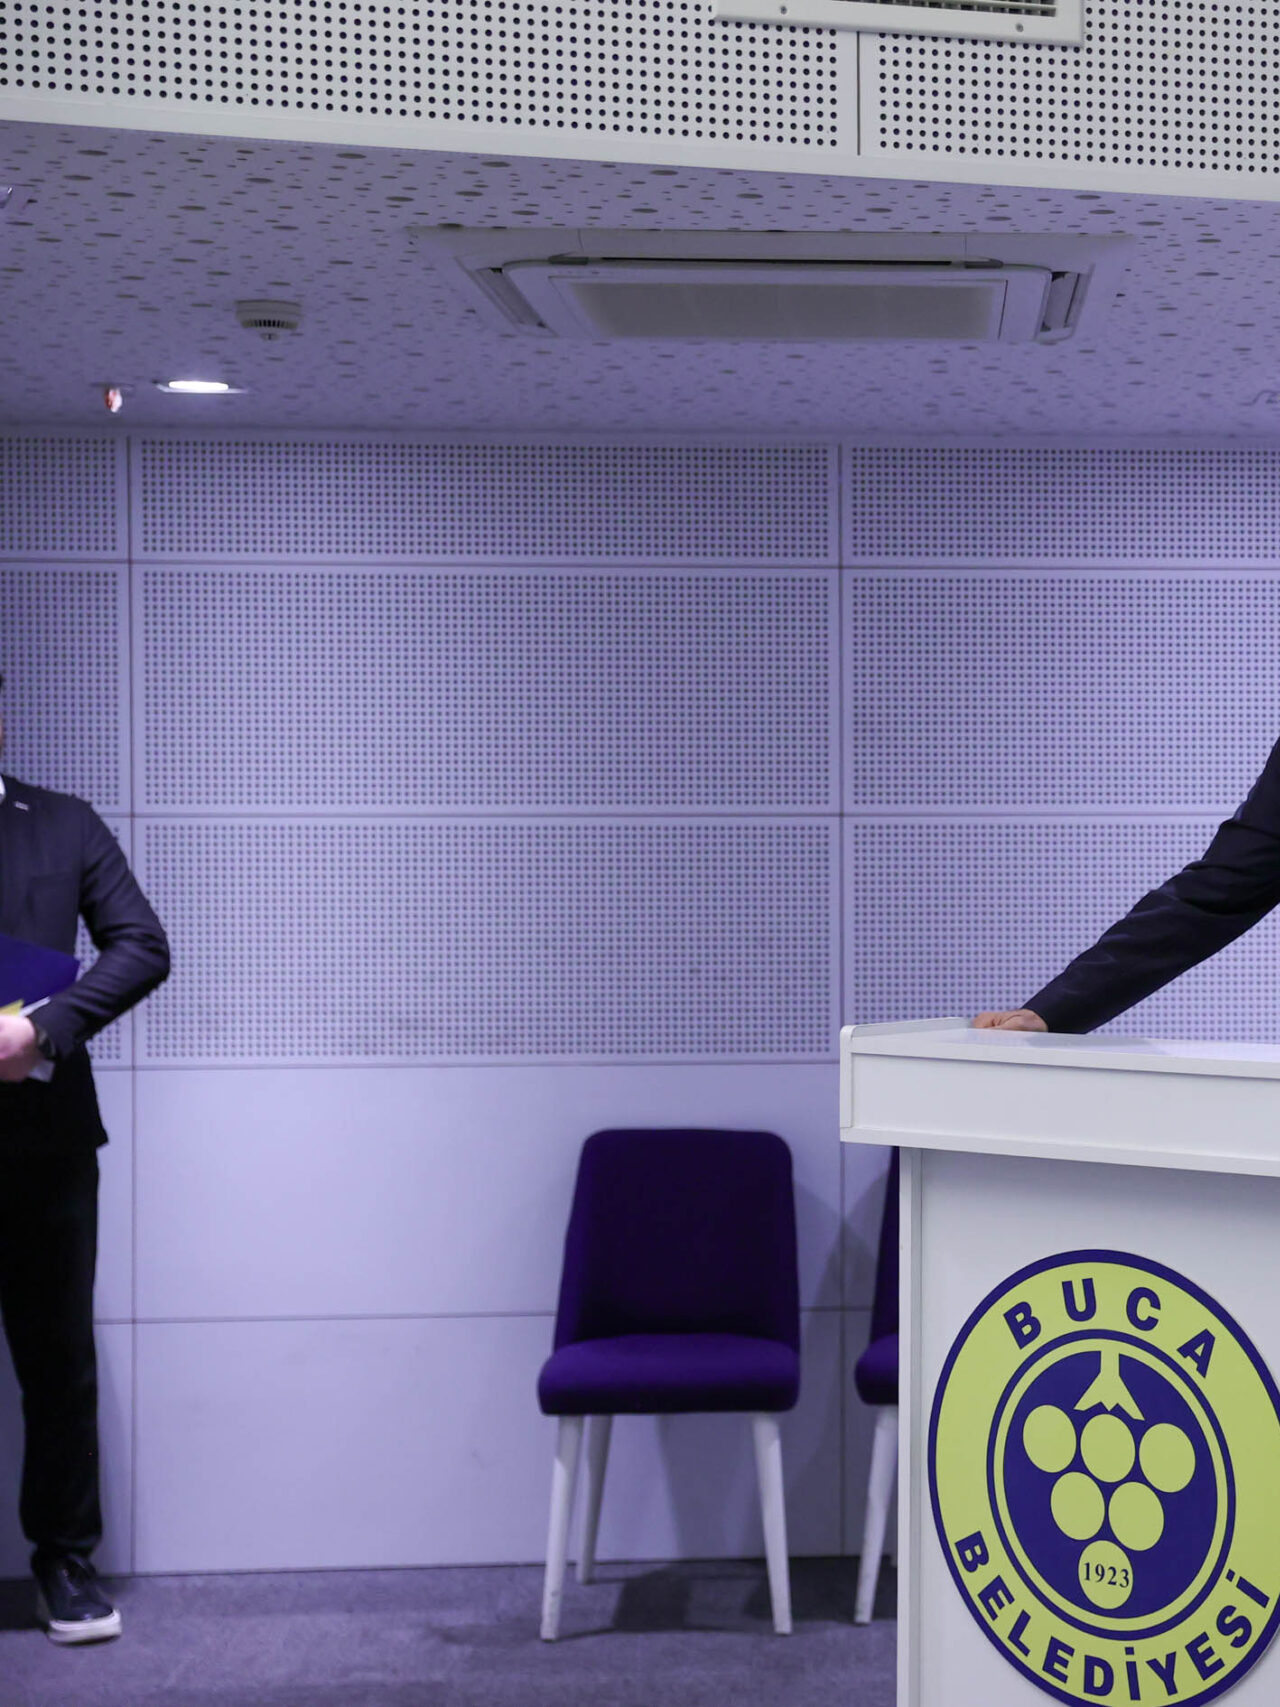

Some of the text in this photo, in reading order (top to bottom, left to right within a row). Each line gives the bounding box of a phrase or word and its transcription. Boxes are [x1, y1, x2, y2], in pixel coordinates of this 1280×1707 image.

[1003, 1277, 1216, 1379] BUCA
[954, 1530, 1270, 1701] BELEDİYESİ
[1084, 1561, 1130, 1588] 1923
